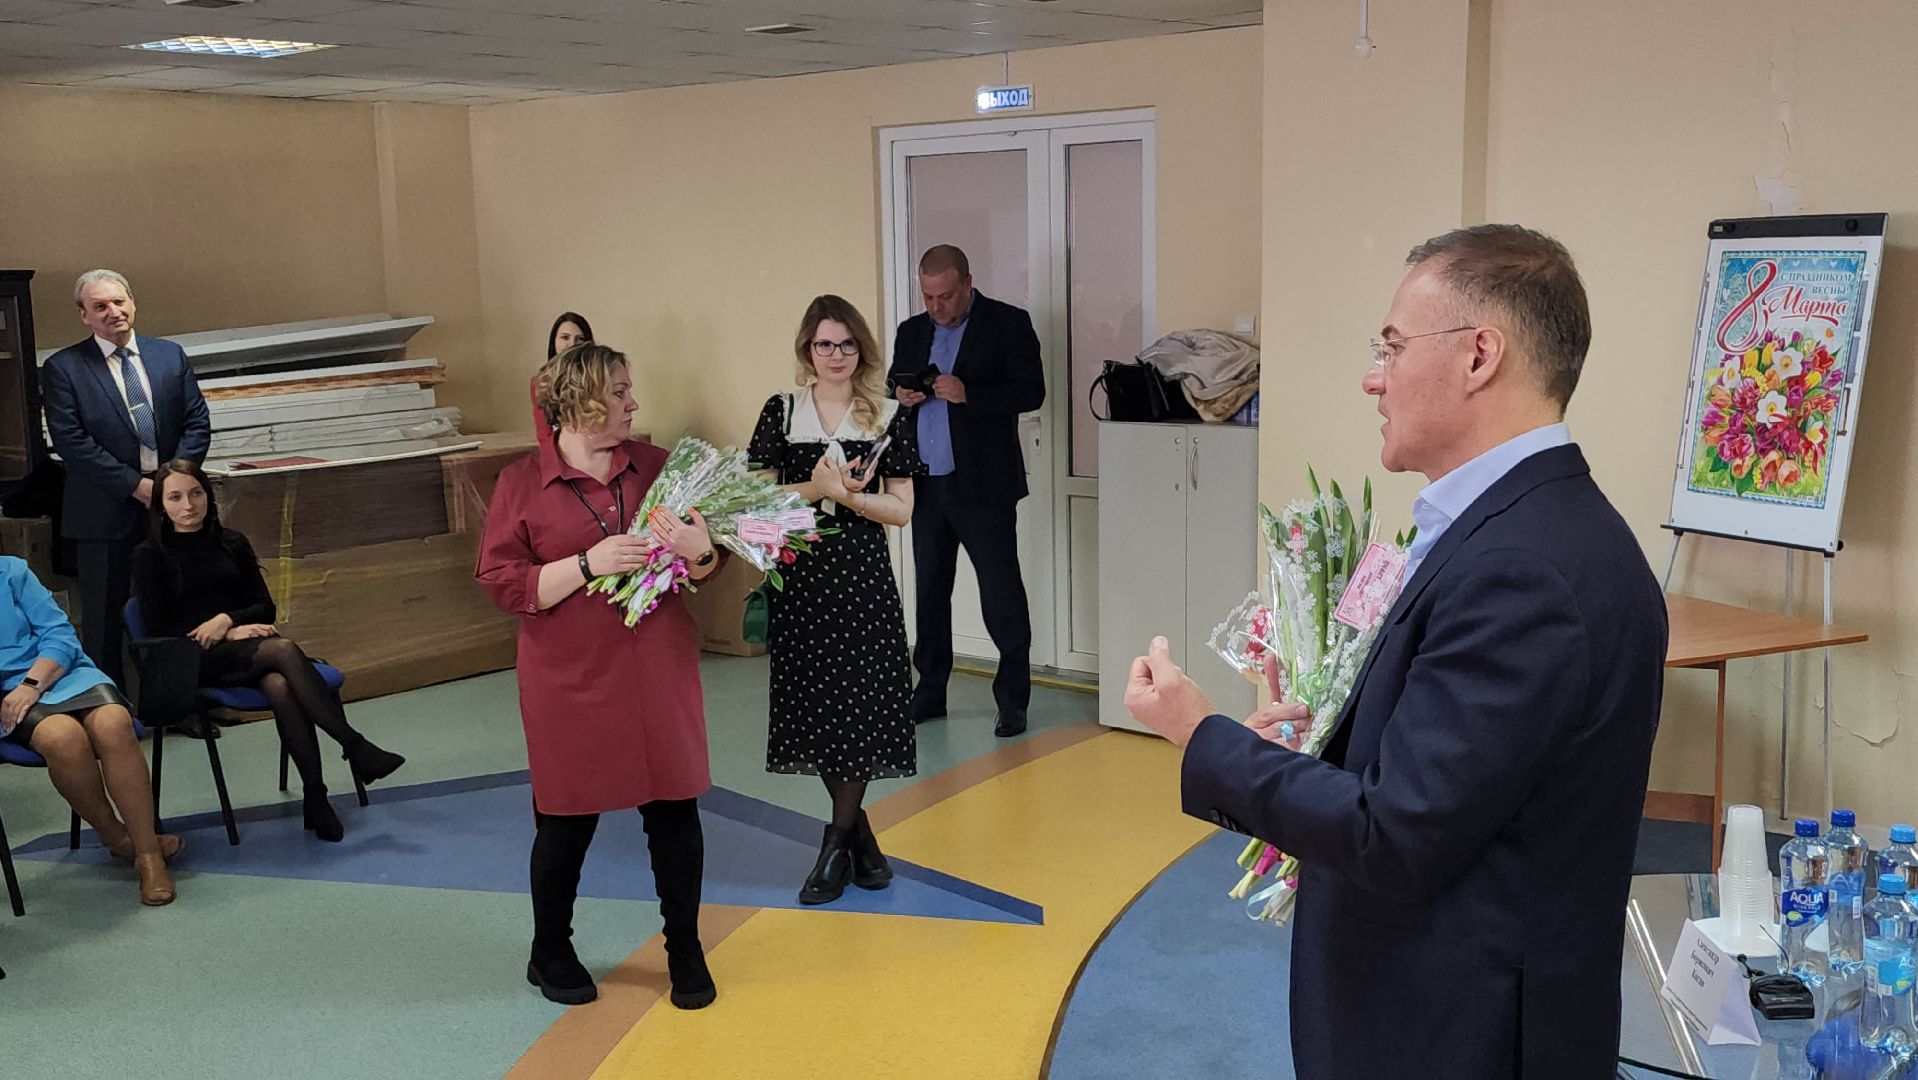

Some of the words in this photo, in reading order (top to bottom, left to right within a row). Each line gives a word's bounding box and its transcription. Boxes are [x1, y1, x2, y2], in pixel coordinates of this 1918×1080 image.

[978, 89, 1029, 109] ЫХОД
[1789, 272, 1851, 282] ПРАЗДНИКОМ
[1716, 261, 1777, 355] 8
[1762, 285, 1848, 322] Марта
[1790, 891, 1825, 904] AQUA
